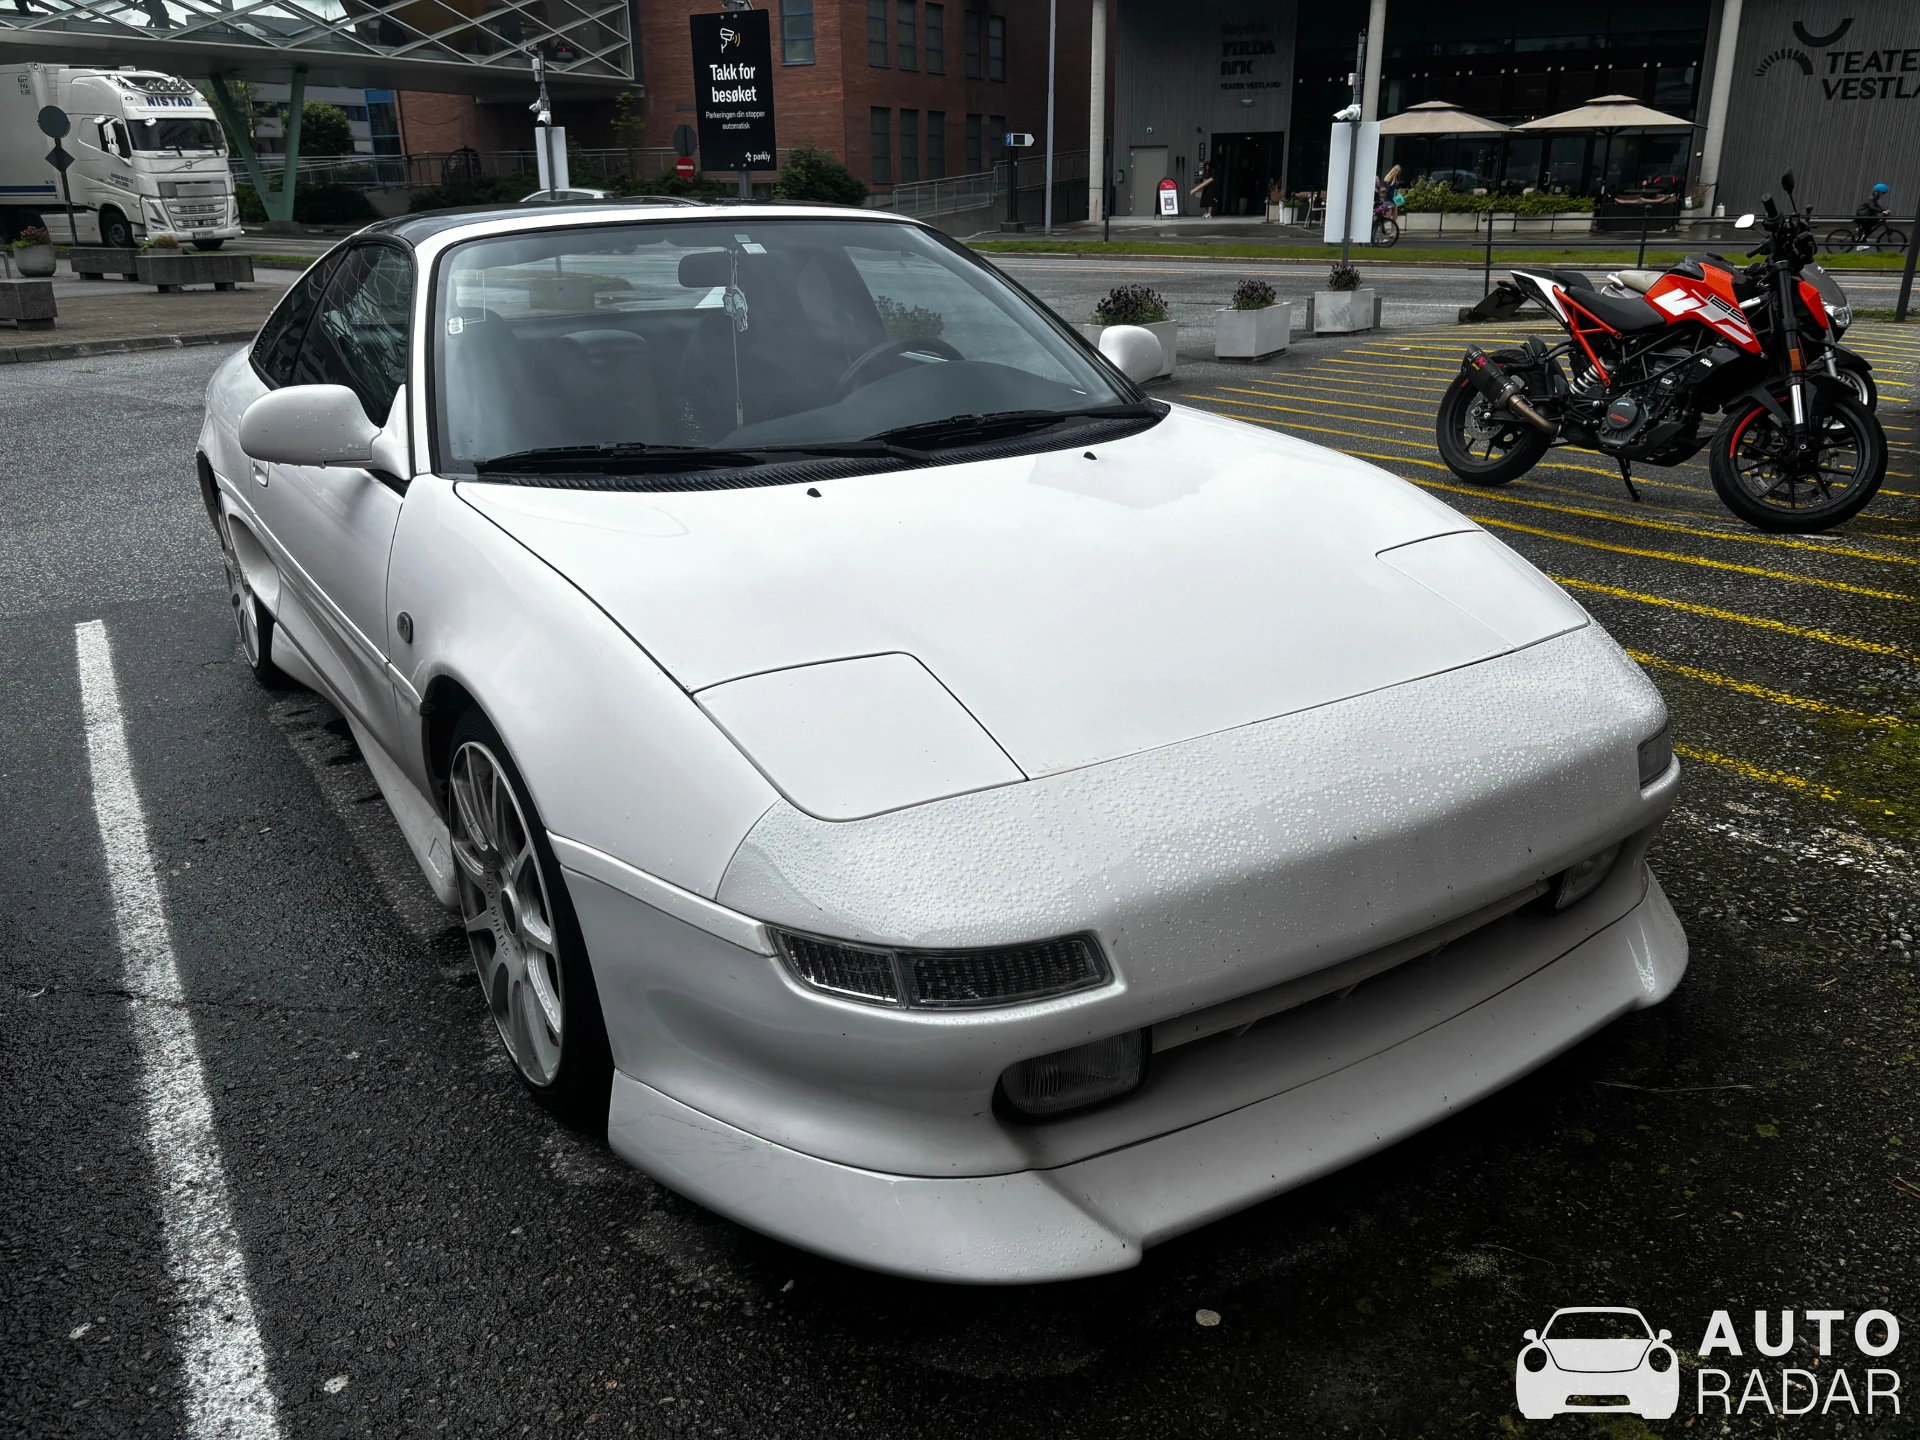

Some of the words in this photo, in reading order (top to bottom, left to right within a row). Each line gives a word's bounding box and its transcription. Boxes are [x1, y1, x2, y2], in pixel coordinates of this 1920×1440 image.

[1222, 40, 1276, 56] FIRDA
[1826, 49, 1920, 74] TEATE
[709, 63, 738, 81] Takk
[739, 62, 756, 80] for
[145, 96, 193, 107] NISTAD
[711, 85, 757, 103] besøket
[753, 151, 770, 162] parkly
[1707, 294, 1747, 325] 125
[1700, 358, 1713, 367] KTM
[490, 905, 509, 957] WHEELS
